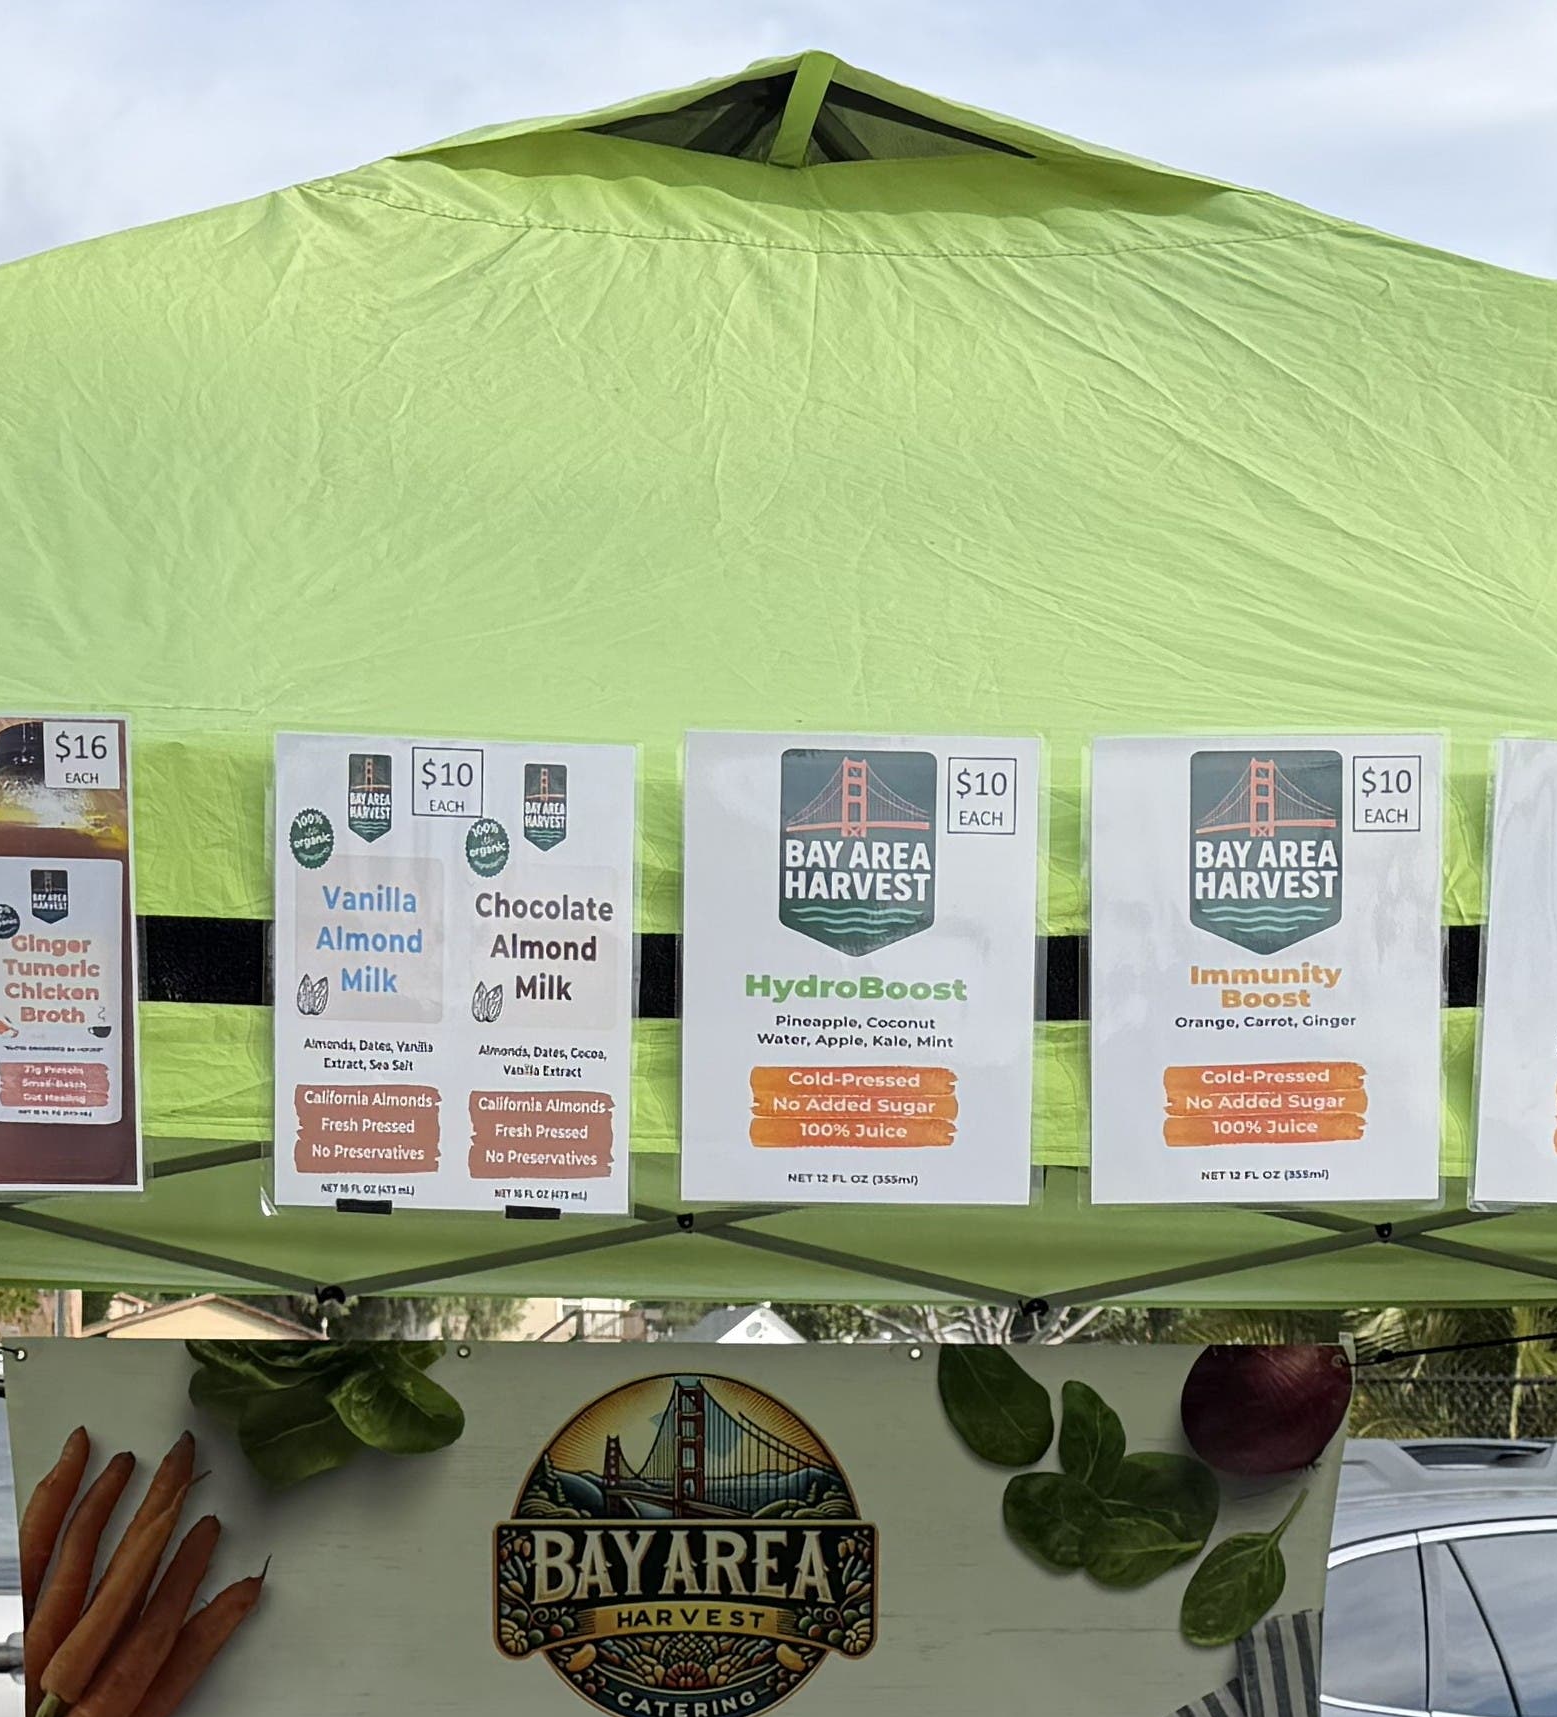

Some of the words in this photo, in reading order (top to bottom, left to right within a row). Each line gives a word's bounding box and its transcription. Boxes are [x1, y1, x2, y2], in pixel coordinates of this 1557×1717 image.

[55, 731, 108, 763] $16
[65, 772, 99, 784] EACH
[421, 759, 473, 789] $10
[1362, 766, 1412, 798] $10
[956, 768, 1008, 798] $10
[430, 800, 464, 813] EACH
[525, 802, 543, 814] BAY
[542, 802, 565, 815] AREA
[525, 814, 565, 828] HARVEST
[959, 811, 1003, 826] EACH
[1365, 808, 1408, 824] EACH
[785, 839, 844, 868] BAY
[849, 842, 931, 870] AREA
[785, 871, 930, 901] HARVEST
[322, 885, 417, 913] Vanilla
[476, 892, 614, 922] Chocolate
[11, 934, 91, 956] Ginger
[316, 927, 422, 953] Almond
[491, 934, 597, 961] Almond
[342, 966, 397, 993] Milk
[1189, 962, 1342, 988] Immunity
[5, 983, 99, 1000] Chicken
[516, 974, 572, 1000] Milk
[746, 975, 967, 1003] HydroBoost
[1222, 989, 1311, 1009] Boost
[20, 1007, 85, 1024] Broth
[776, 1015, 861, 1030] Pineapple,
[867, 1017, 935, 1030] Coconut
[1175, 1016, 1239, 1029] Orange,
[1244, 1016, 1298, 1028] Carrot,
[1303, 1015, 1356, 1028] Ginger
[304, 1038, 355, 1051] Almonds,
[360, 1040, 394, 1053] Dates,
[397, 1041, 433, 1053] Vanilla
[757, 1033, 810, 1047] Water,
[815, 1035, 867, 1048] Apple,
[873, 1036, 912, 1048] Kale,
[917, 1036, 953, 1048] Mint
[324, 1058, 367, 1072] Extract,
[370, 1060, 389, 1071] Sea
[392, 1060, 413, 1071] Salt
[789, 1072, 920, 1087] Cold-Pressed
[305, 1091, 369, 1105] California
[372, 1093, 432, 1107] Almonds
[773, 1097, 800, 1112] No
[806, 1099, 871, 1112] Added
[877, 1100, 936, 1115] Sugar
[322, 1118, 359, 1132] Fresh
[363, 1119, 414, 1133] Pressed
[800, 1123, 850, 1137] 100%
[855, 1124, 907, 1138] Juice
[312, 1144, 330, 1157] No
[335, 1145, 424, 1160] Preservatives
[788, 1174, 813, 1183] NET
[817, 1174, 829, 1183] 12
[833, 1175, 847, 1183] FL
[851, 1175, 868, 1183] OZ
[530, 1530, 657, 1604] BAY
[657, 1530, 836, 1604] AREA
[617, 1608, 766, 1630] HARVEST
